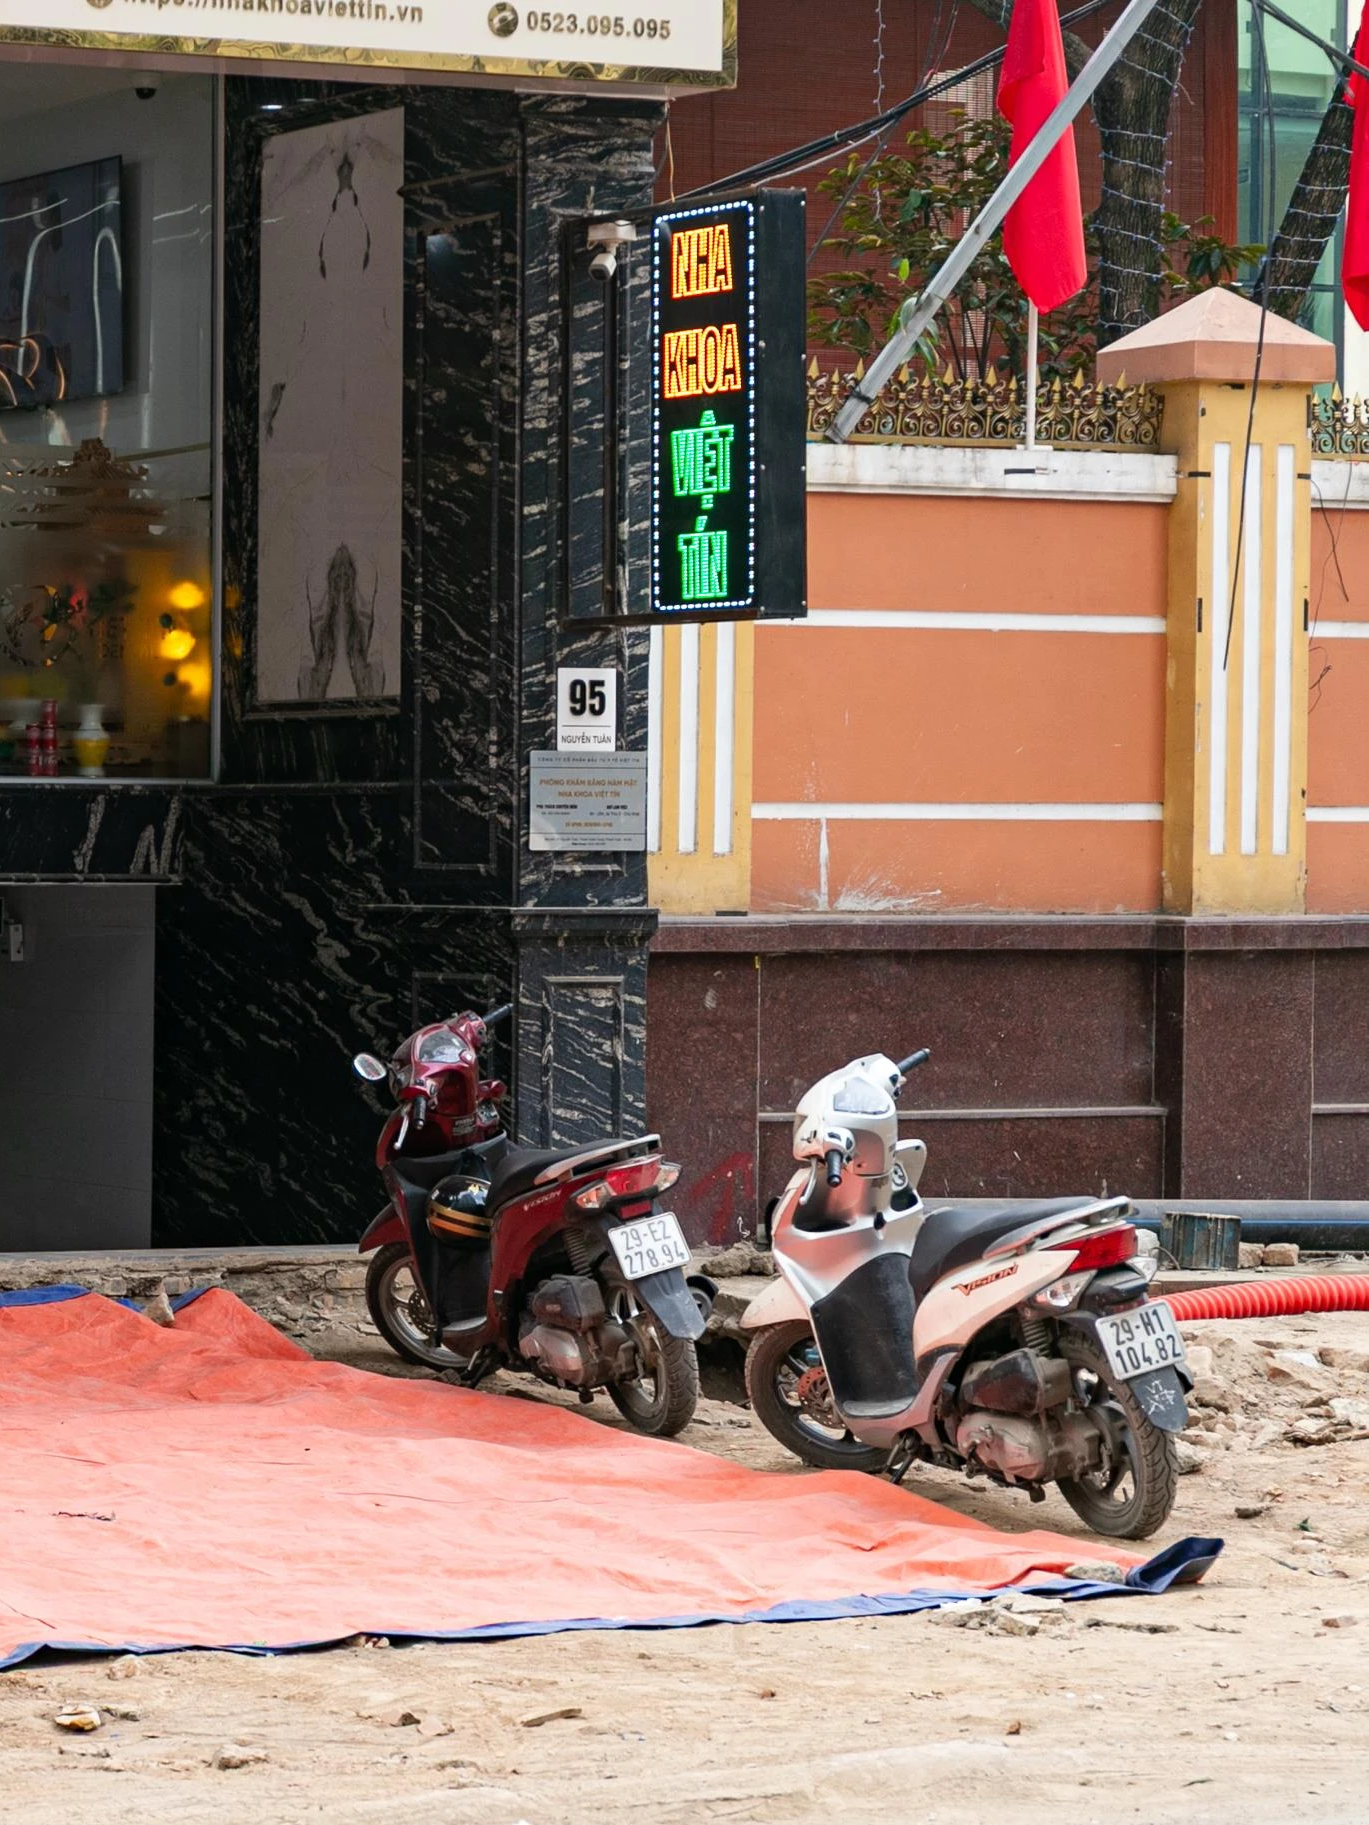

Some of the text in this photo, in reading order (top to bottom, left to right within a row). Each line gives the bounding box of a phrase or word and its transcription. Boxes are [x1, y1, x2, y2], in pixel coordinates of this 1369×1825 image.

[526, 10, 672, 40] 0523.095.095
[671, 223, 734, 299] NHA
[663, 323, 742, 399] KHOA
[670, 410, 735, 510] VIỆT
[569, 679, 606, 716] 95
[621, 1220, 671, 1251] 29-E2
[624, 1241, 685, 1274] 278.94
[951, 1263, 1019, 1296] VISION
[1110, 1308, 1167, 1346] 29-H1
[1115, 1334, 1181, 1375] 104.82
